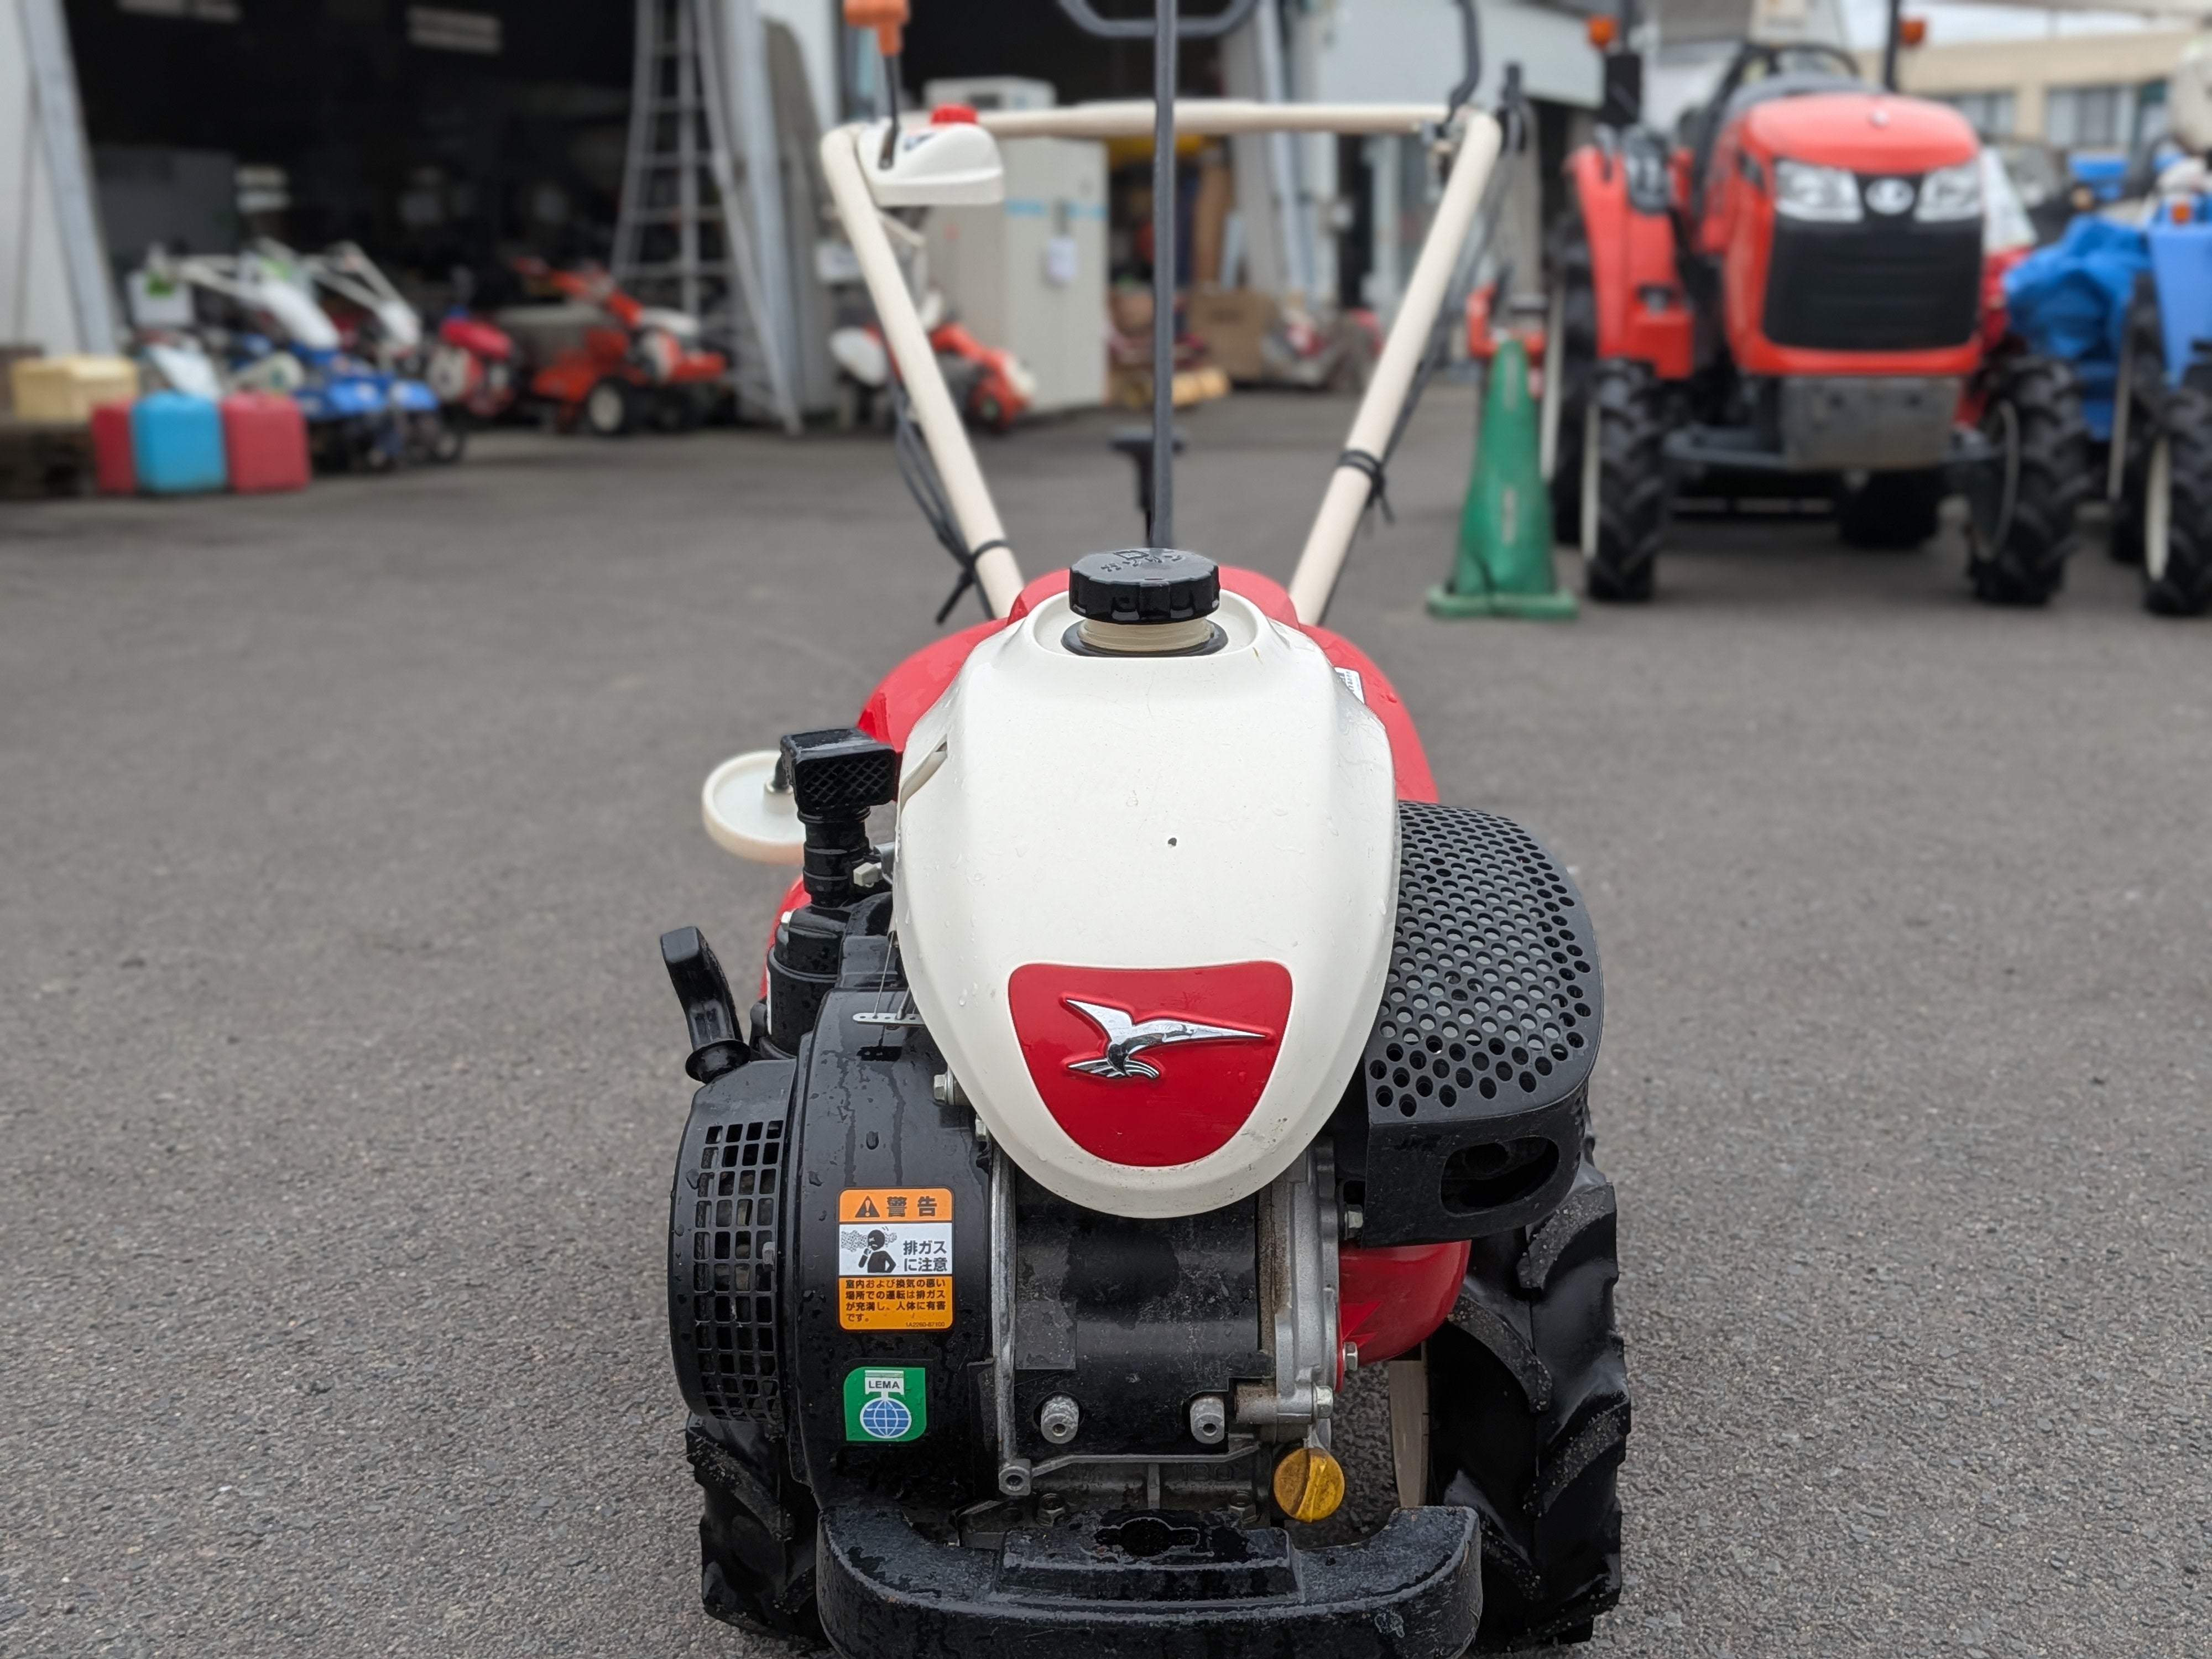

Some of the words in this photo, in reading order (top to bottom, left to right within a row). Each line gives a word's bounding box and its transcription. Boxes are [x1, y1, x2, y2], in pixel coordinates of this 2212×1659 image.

[886, 1196, 937, 1217] 警告
[903, 1240, 947, 1255] 排ガス
[904, 1257, 948, 1272] に注意
[845, 1290, 946, 1300] 場所での運転は排ガス
[846, 1313, 869, 1322] です。
[868, 1380, 900, 1389] LEMA
